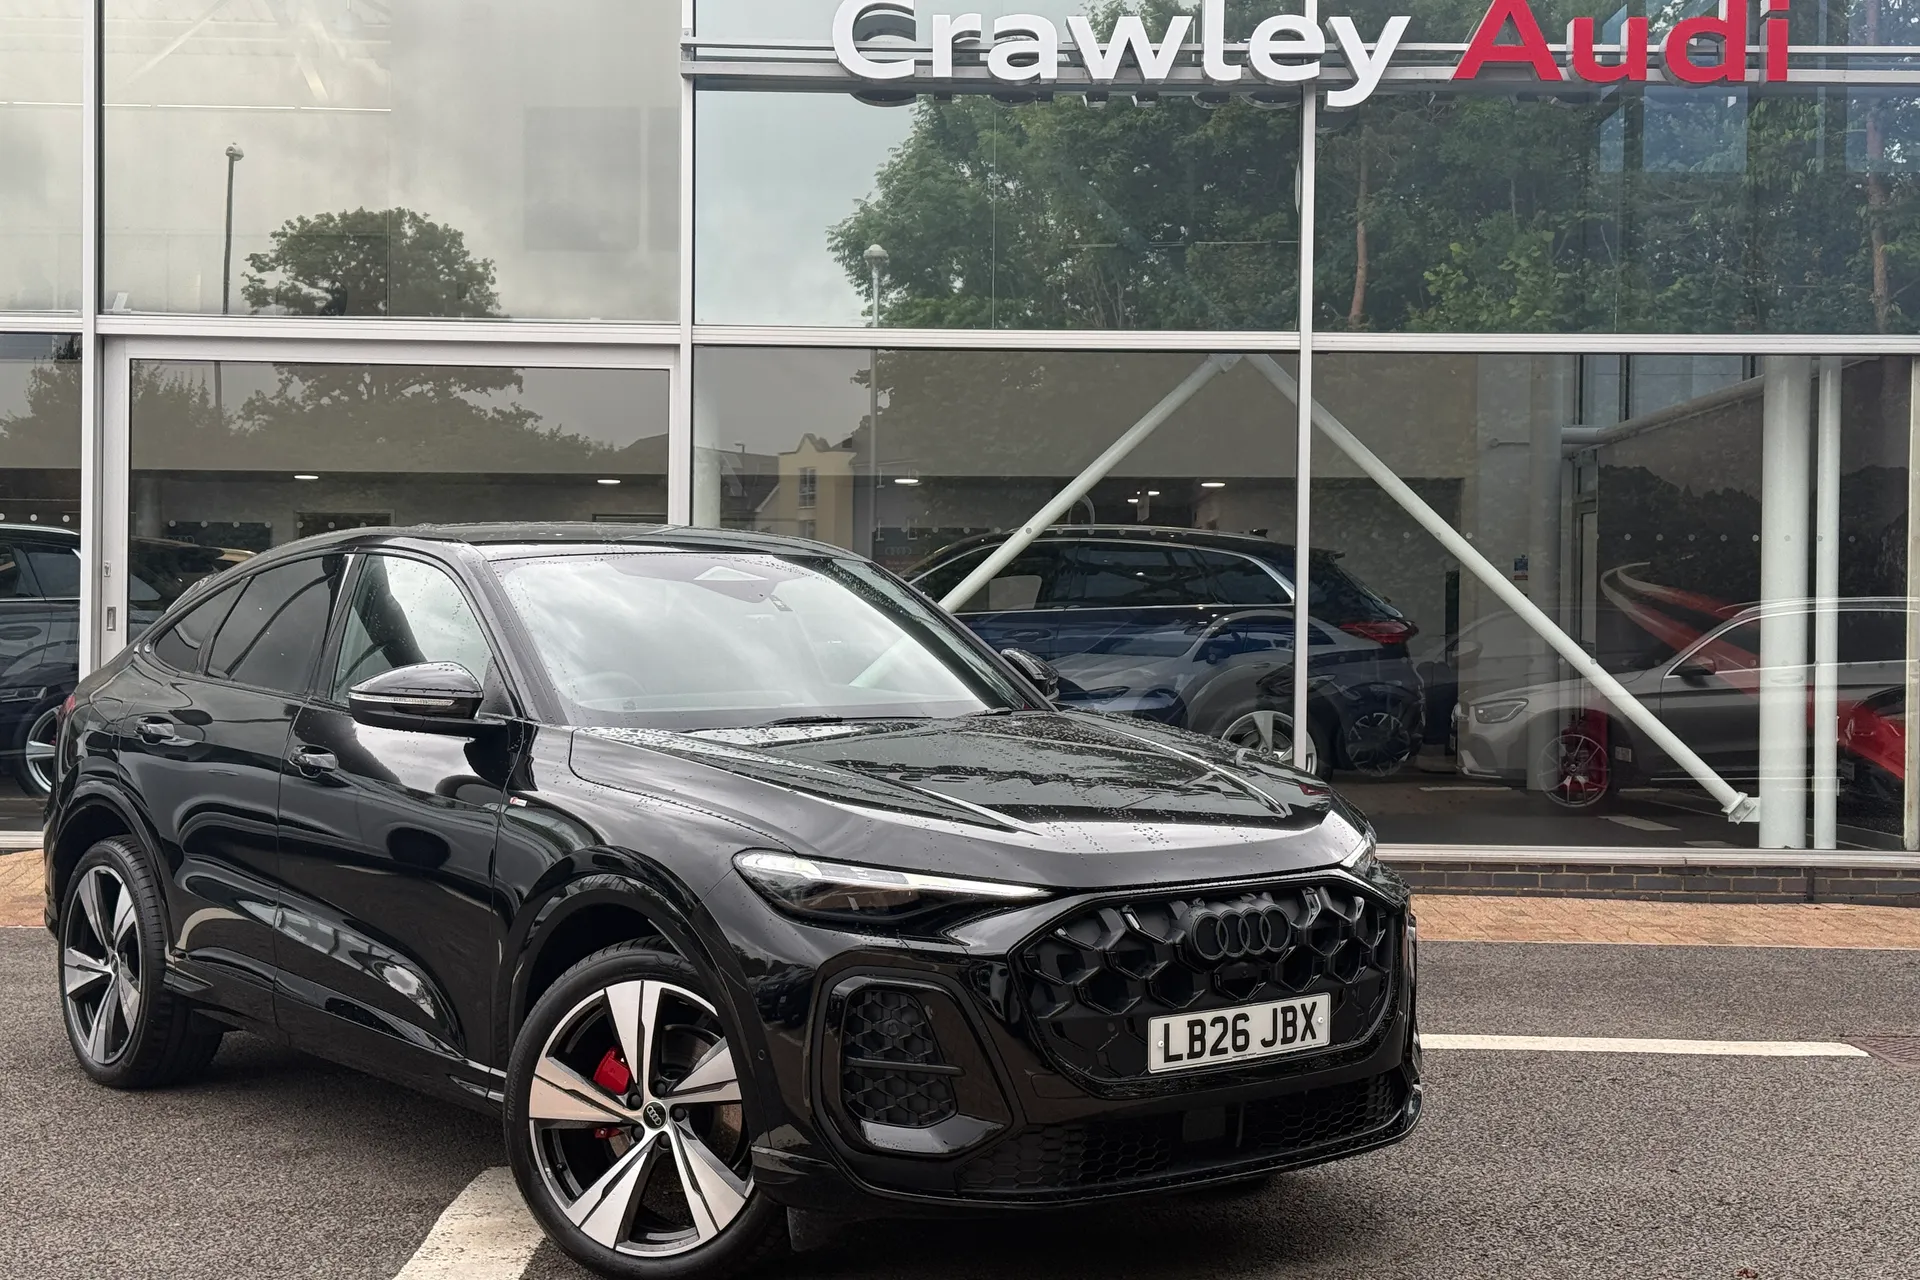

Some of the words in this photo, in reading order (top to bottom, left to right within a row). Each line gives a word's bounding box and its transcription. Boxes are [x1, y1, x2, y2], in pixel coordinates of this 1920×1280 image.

[832, 0, 1412, 107] Crawley
[1453, 0, 1789, 83] Audi
[1163, 1012, 1250, 1063] LB26
[1260, 1001, 1317, 1048] JBX
